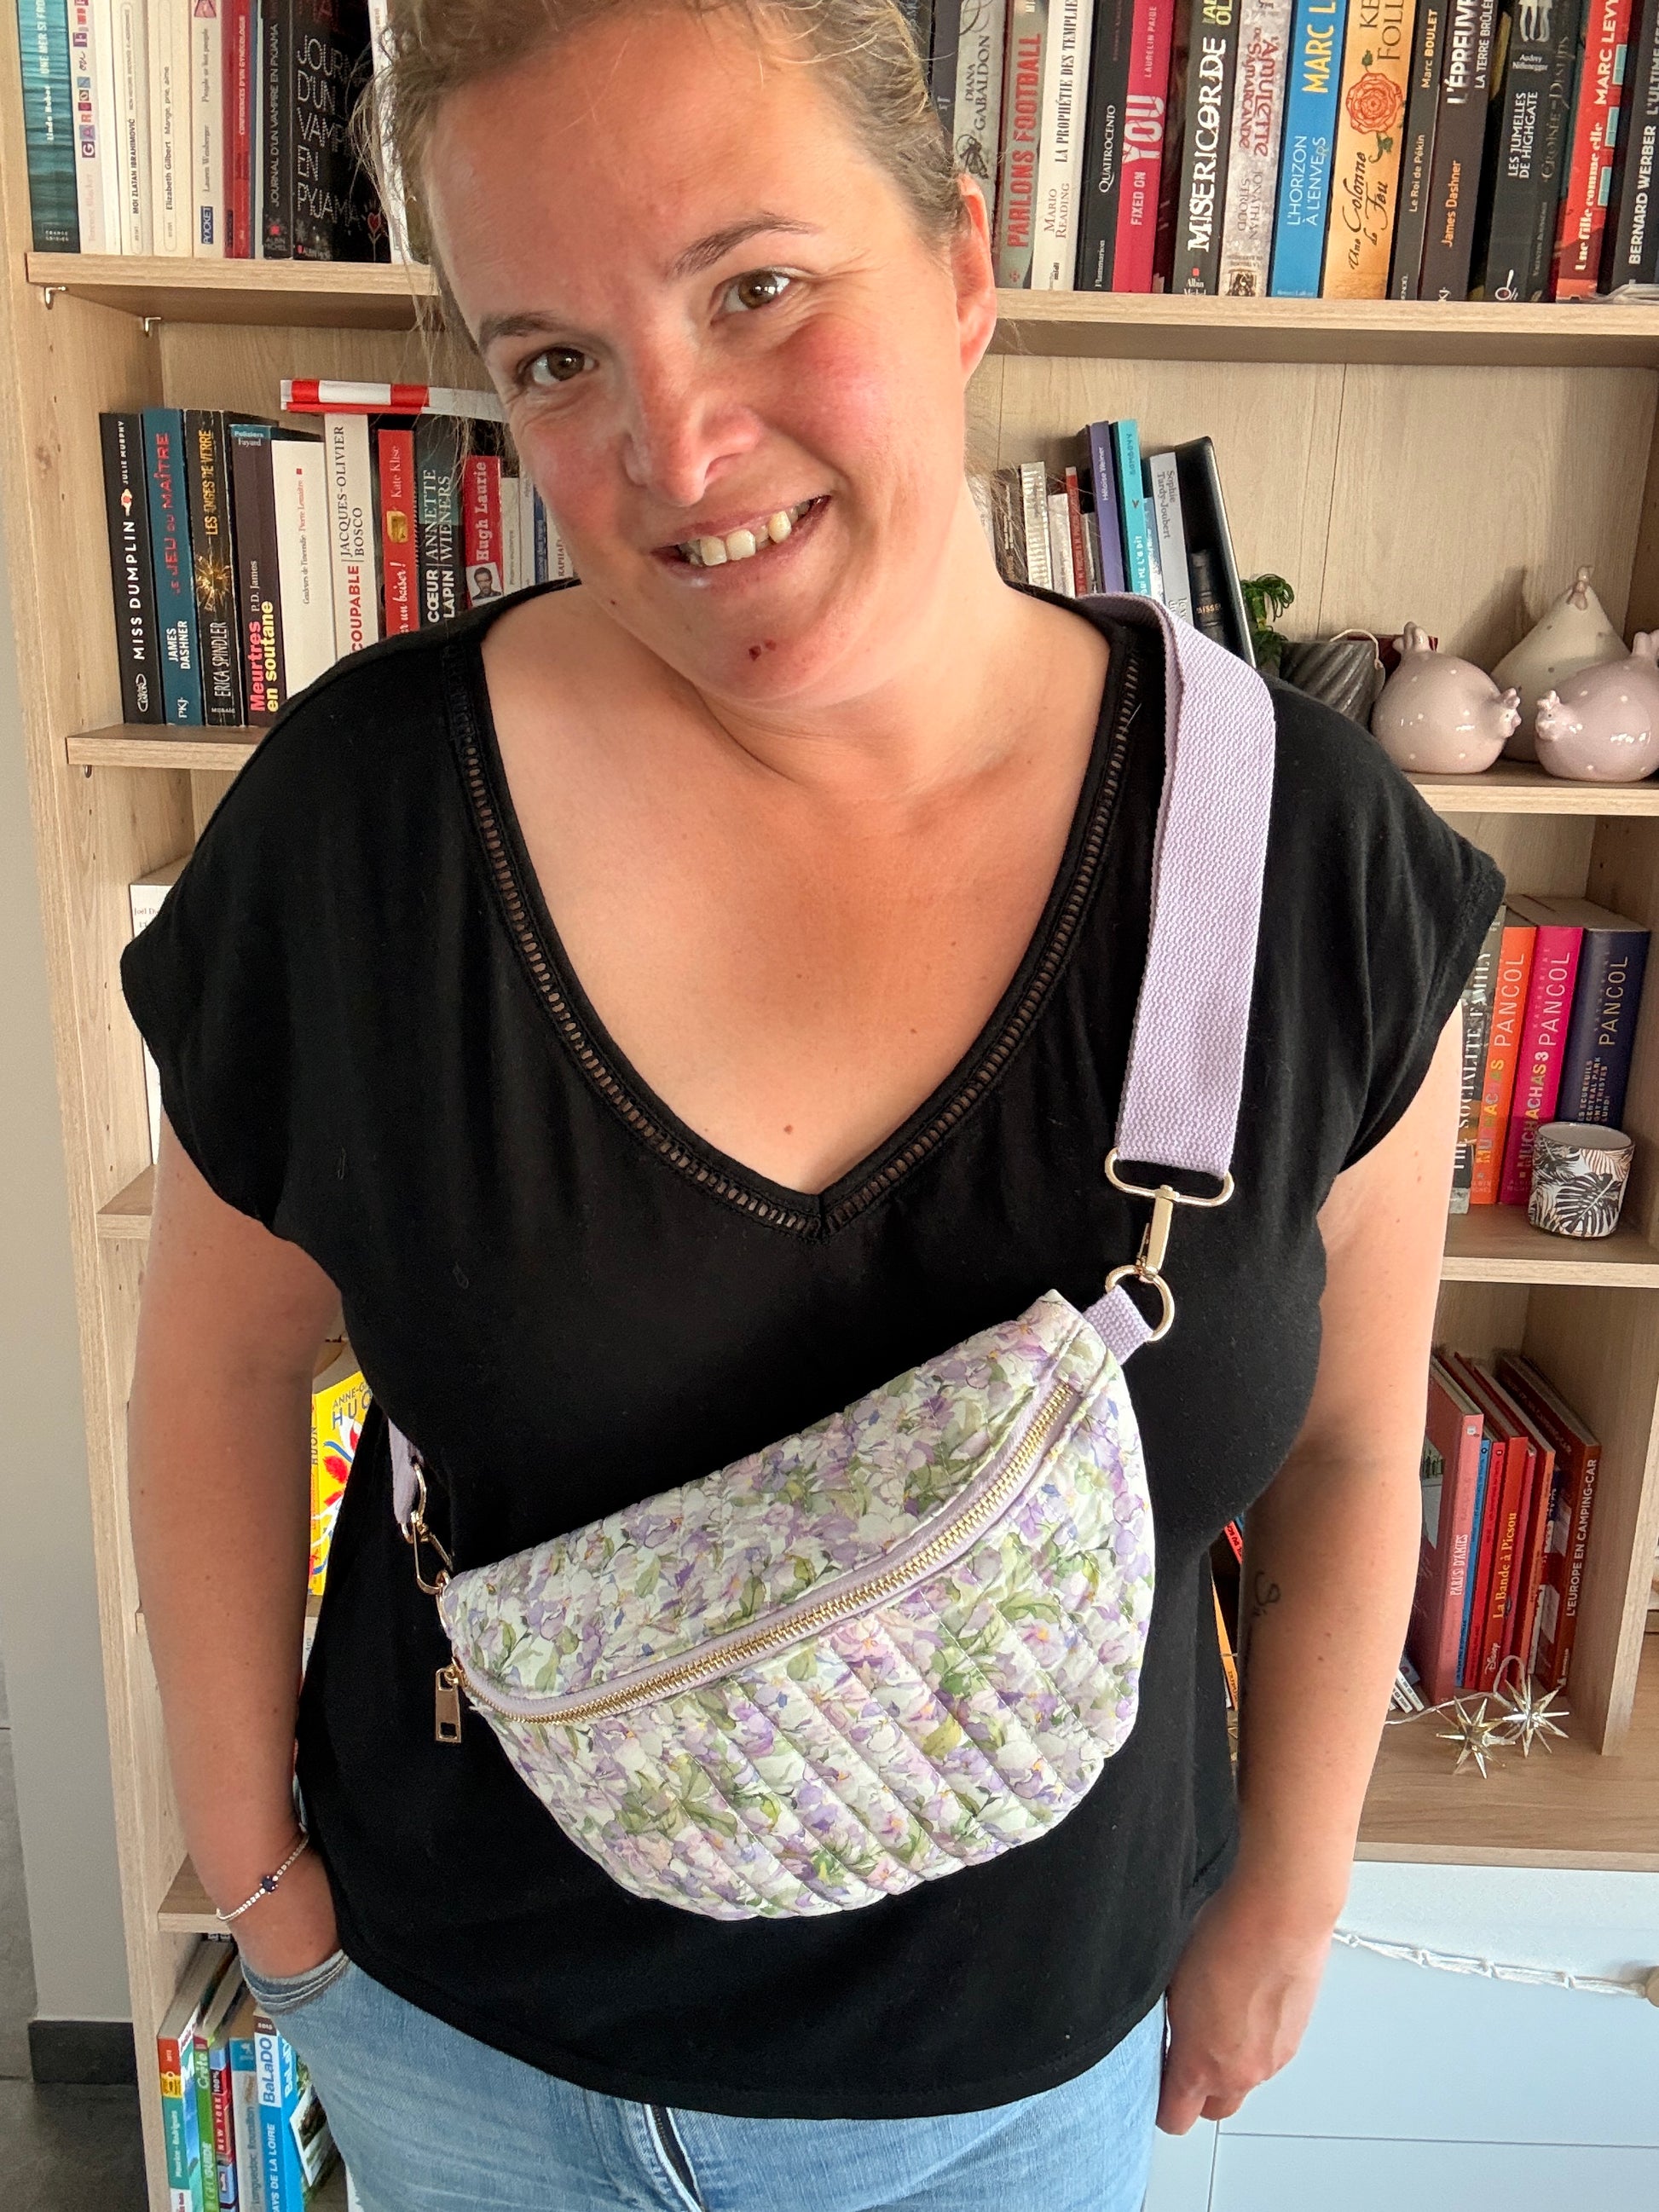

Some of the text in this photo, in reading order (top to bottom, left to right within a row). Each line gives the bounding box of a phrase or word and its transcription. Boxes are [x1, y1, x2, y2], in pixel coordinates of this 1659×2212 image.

[269, 23, 279, 66] PYJAMA
[1060, 55, 1074, 76] DES
[1143, 6, 1157, 78] LAURELIN PAIGE
[1302, 24, 1334, 94] MARC
[1421, 9, 1438, 89] Marc BOULET
[1475, 39, 1490, 90] LA TERRE
[270, 69, 279, 83] EN
[270, 85, 280, 129] VAMPIRE
[964, 64, 976, 101] DIANA
[973, 35, 990, 130] GABALDON
[1239, 43, 1262, 148] SAMARCANDE
[1253, 37, 1280, 157] L'AMULETTE
[1593, 49, 1613, 107] MARC
[126, 118, 137, 169] IBRAHIMOVIĆ
[1007, 33, 1041, 247] PARLONS FOOTBALL
[1053, 78, 1072, 144] PROPHÉTIE
[1121, 94, 1165, 165] YOU
[1508, 92, 1526, 177] LES JUMELLES
[1519, 91, 1538, 179] DE HIGHGATE
[164, 141, 172, 170] Gilbert
[1054, 149, 1069, 163] LA
[1098, 105, 1116, 193] QUATTROCENTO
[1187, 37, 1227, 253] MISERICORDE
[1408, 135, 1425, 213] Le Roi de Pékin
[165, 173, 173, 210] Elizabeth
[270, 157, 280, 207] JOURNAL
[1043, 188, 1057, 233] MARIO
[1055, 182, 1070, 239] READING
[1130, 171, 1146, 226] FIXED ON
[1236, 177, 1250, 232] STROUD
[1247, 172, 1263, 240] JONATHAN
[1286, 136, 1307, 226] L'HORIZON
[1304, 136, 1329, 226] À L'ENVERS
[1342, 152, 1366, 234] Colonne
[1364, 182, 1389, 231] Feu
[1442, 160, 1462, 248] James Dashner
[1575, 122, 1604, 271] Une fille comme elle
[1628, 124, 1656, 265] BERNARD WERBER
[201, 206, 212, 245] POCKET
[1095, 240, 1106, 288] Flammarion
[1186, 278, 1205, 288] Albin
[118, 420, 129, 485] JULIE MURPHY
[153, 432, 174, 509] MAÎTRE
[199, 430, 213, 464] VERRE
[333, 426, 352, 557] JACQUES-OLIVIER
[390, 474, 403, 499] Kate
[422, 469, 439, 561] ANNETTE
[437, 475, 453, 561] WIENERS
[472, 461, 493, 562] Hugh Laurie
[1156, 471, 1171, 540] Tardy-Joubert
[1165, 470, 1177, 503] Sophie
[166, 513, 176, 532] DU
[205, 516, 219, 536] LES
[351, 507, 365, 557] BOSCO
[164, 537, 178, 576] JEU
[248, 560, 260, 613] P.D. James
[122, 521, 146, 661] MISS DUMPLIN
[347, 565, 364, 652] COUPABLE
[392, 569, 409, 621] un baiser
[425, 569, 440, 623] CŒUR
[442, 570, 456, 619] LAPIN
[166, 627, 180, 662] JAMES
[178, 621, 192, 670] DASHNER
[210, 621, 232, 697] ERICA SPINDLER
[246, 621, 267, 712] Meurtres
[260, 601, 279, 713] en soutane
[1469, 952, 1490, 1017] FAMILY
[1494, 953, 1525, 1047] PANCOL
[1538, 951, 1570, 1047] PANCOL
[1598, 956, 1628, 1046] PANCOL
[1591, 1056, 1601, 1080] PARK
[1517, 1063, 1547, 1168] MUCHACHAS
[1535, 1051, 1550, 1062] 3
[1492, 1513, 1517, 1620] La Bande à Picsou
[1565, 1458, 1598, 1618] L'EUROPE EN CAMPING-CAR
[1483, 1643, 1500, 1676] Disney
[212, 2071, 221, 2093] 100%
[258, 2037, 275, 2104] BaLaDO
[214, 2097, 223, 2123] YORK
[266, 2122, 279, 2190] DE LA LOIRE
